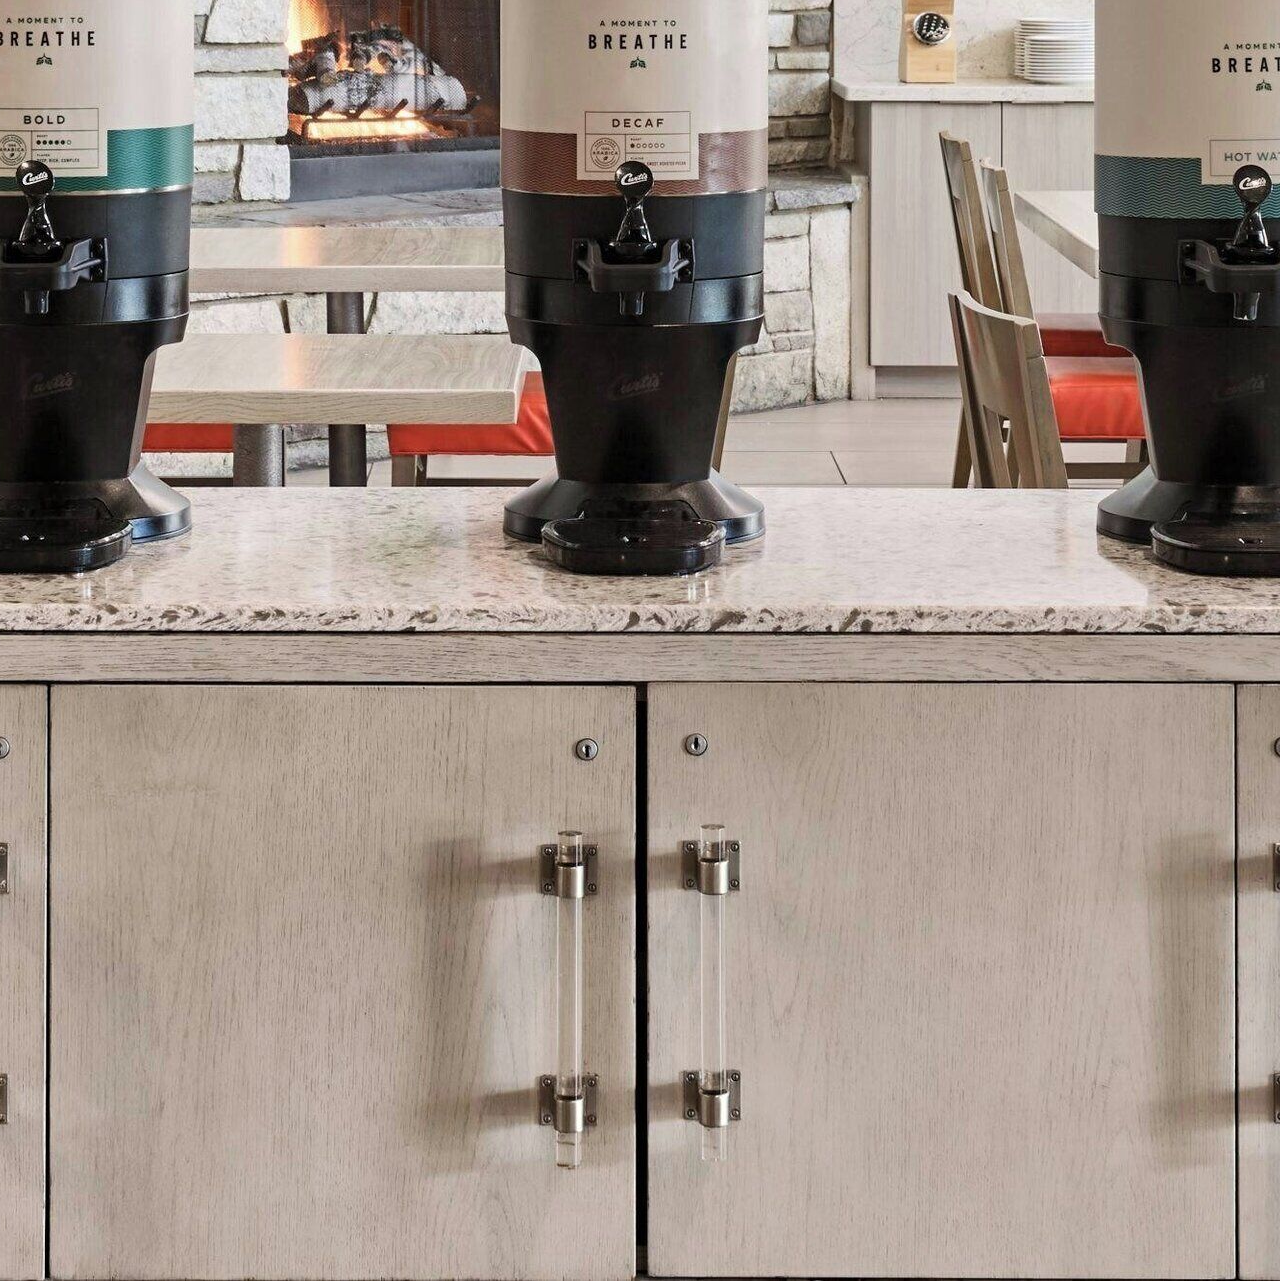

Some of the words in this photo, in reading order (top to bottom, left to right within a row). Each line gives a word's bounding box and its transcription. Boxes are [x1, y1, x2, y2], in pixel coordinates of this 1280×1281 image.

[588, 34, 688, 50] BREATHE
[23, 115, 66, 125] BOLD
[611, 118, 665, 128] DECAF
[1224, 152, 1252, 162] HOT
[22, 171, 49, 186] Curtis
[620, 172, 649, 186] Curtis
